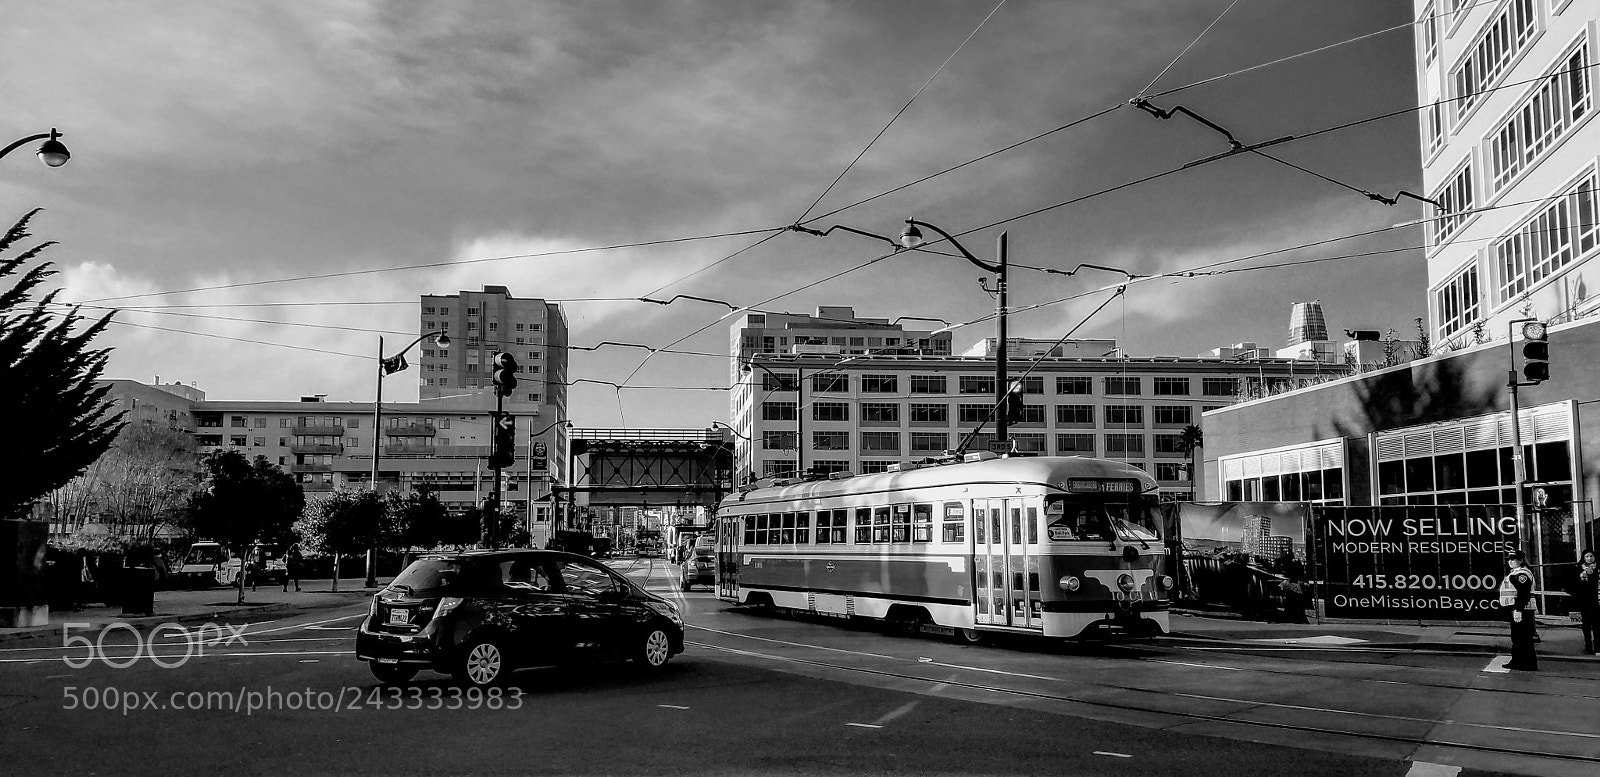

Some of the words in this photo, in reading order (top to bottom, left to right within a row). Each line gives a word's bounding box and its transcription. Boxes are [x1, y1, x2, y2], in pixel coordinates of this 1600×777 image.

[1106, 482, 1134, 492] FERRIES
[1328, 519, 1393, 537] NOW
[1402, 517, 1517, 536] SELLING
[1333, 542, 1403, 554] MODERN
[1409, 541, 1514, 553] RESIDENCES
[1352, 574, 1497, 590] 415.820.1000
[1333, 594, 1500, 611] OneMissionBay.co
